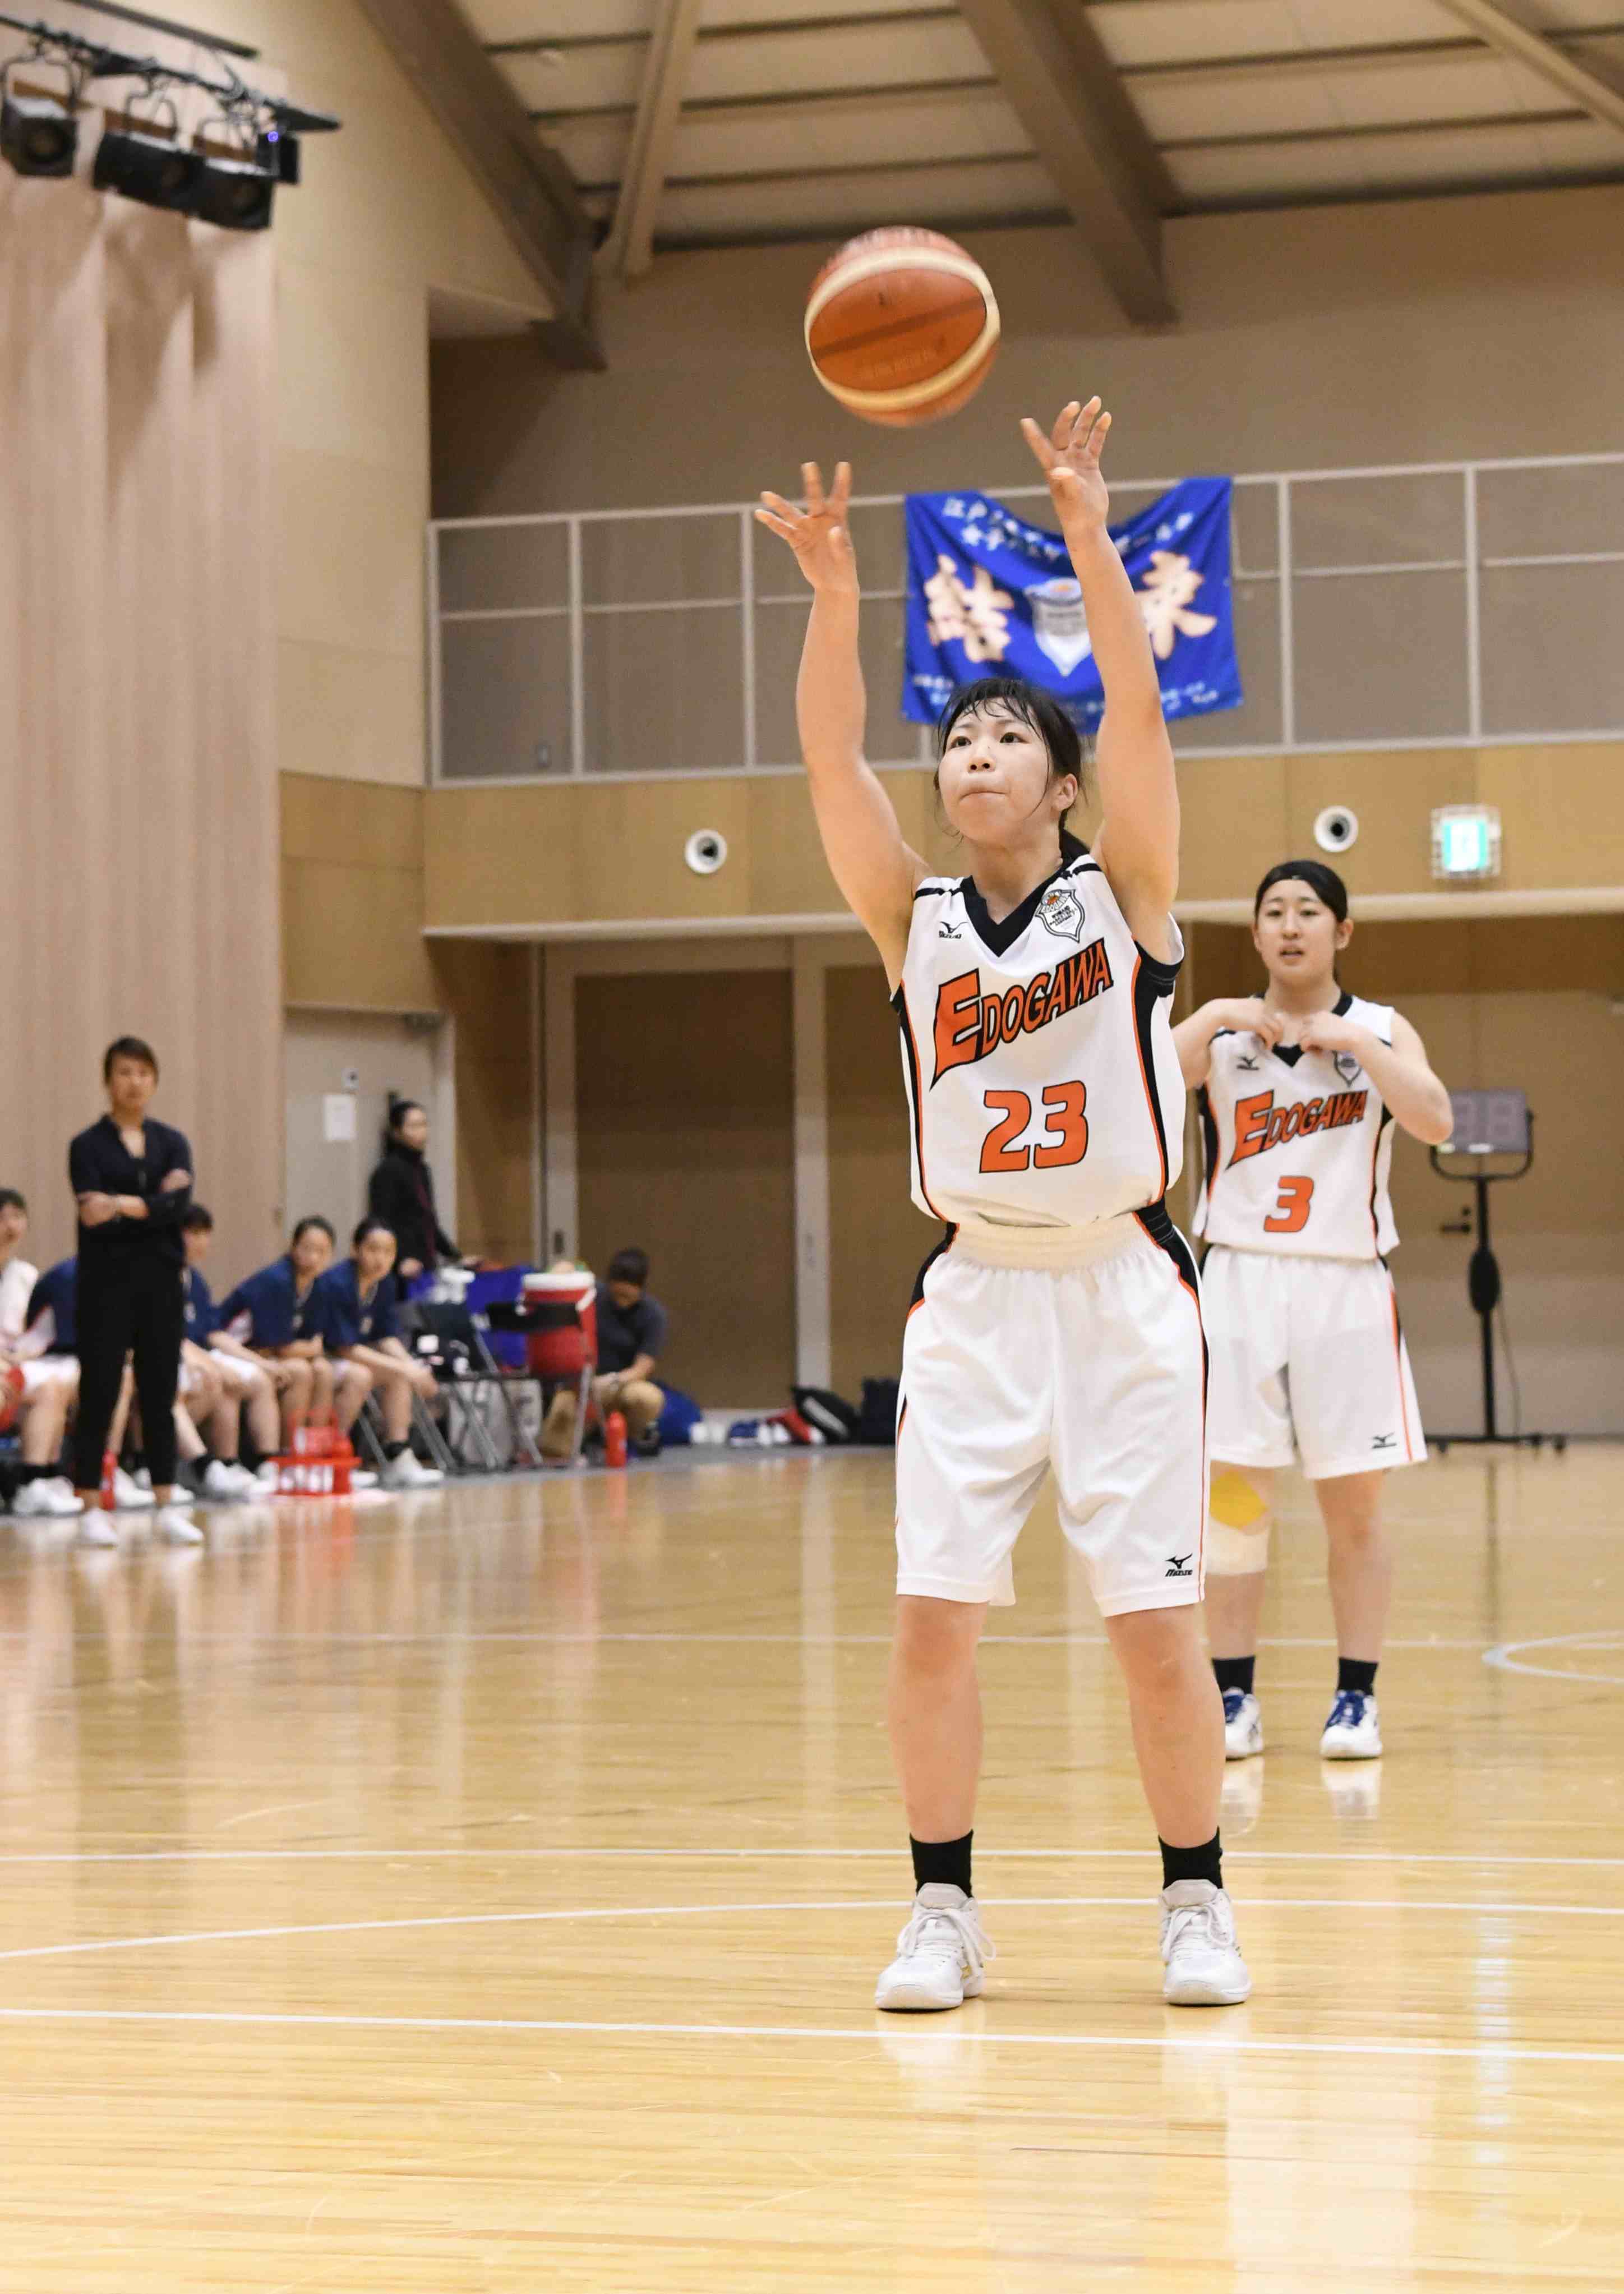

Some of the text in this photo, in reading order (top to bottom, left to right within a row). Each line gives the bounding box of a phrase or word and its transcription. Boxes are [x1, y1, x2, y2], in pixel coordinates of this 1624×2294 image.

[929, 938, 1114, 1091] EDOGAWA
[979, 1080, 1088, 1173] 23
[1225, 1089, 1368, 1169] EDOGAWA
[1263, 1176, 1314, 1233] 3
